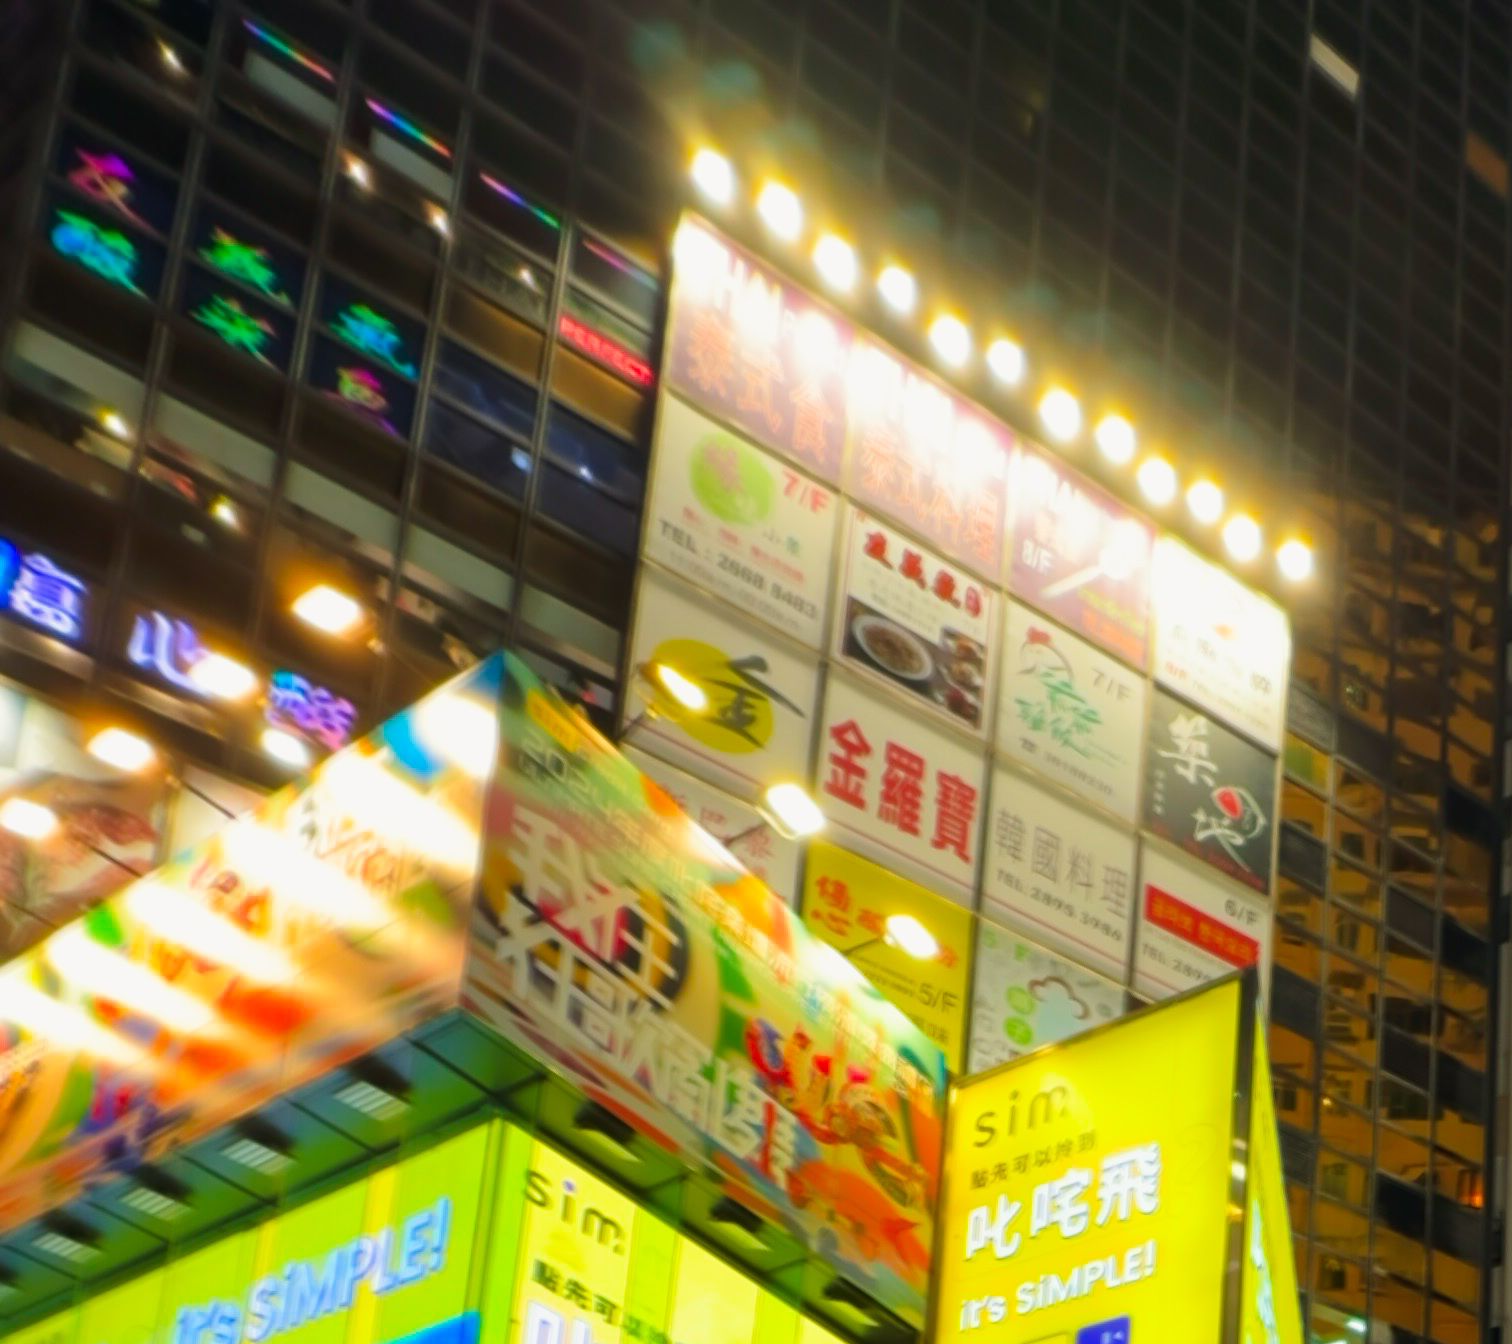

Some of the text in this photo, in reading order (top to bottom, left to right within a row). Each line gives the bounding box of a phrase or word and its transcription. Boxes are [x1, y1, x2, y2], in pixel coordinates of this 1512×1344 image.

[825, 720, 977, 864] 金羅寶
[973, 1085, 1067, 1148] sim
[526, 1167, 624, 1255] sim
[964, 1141, 1161, 1260] 叱咤飛
